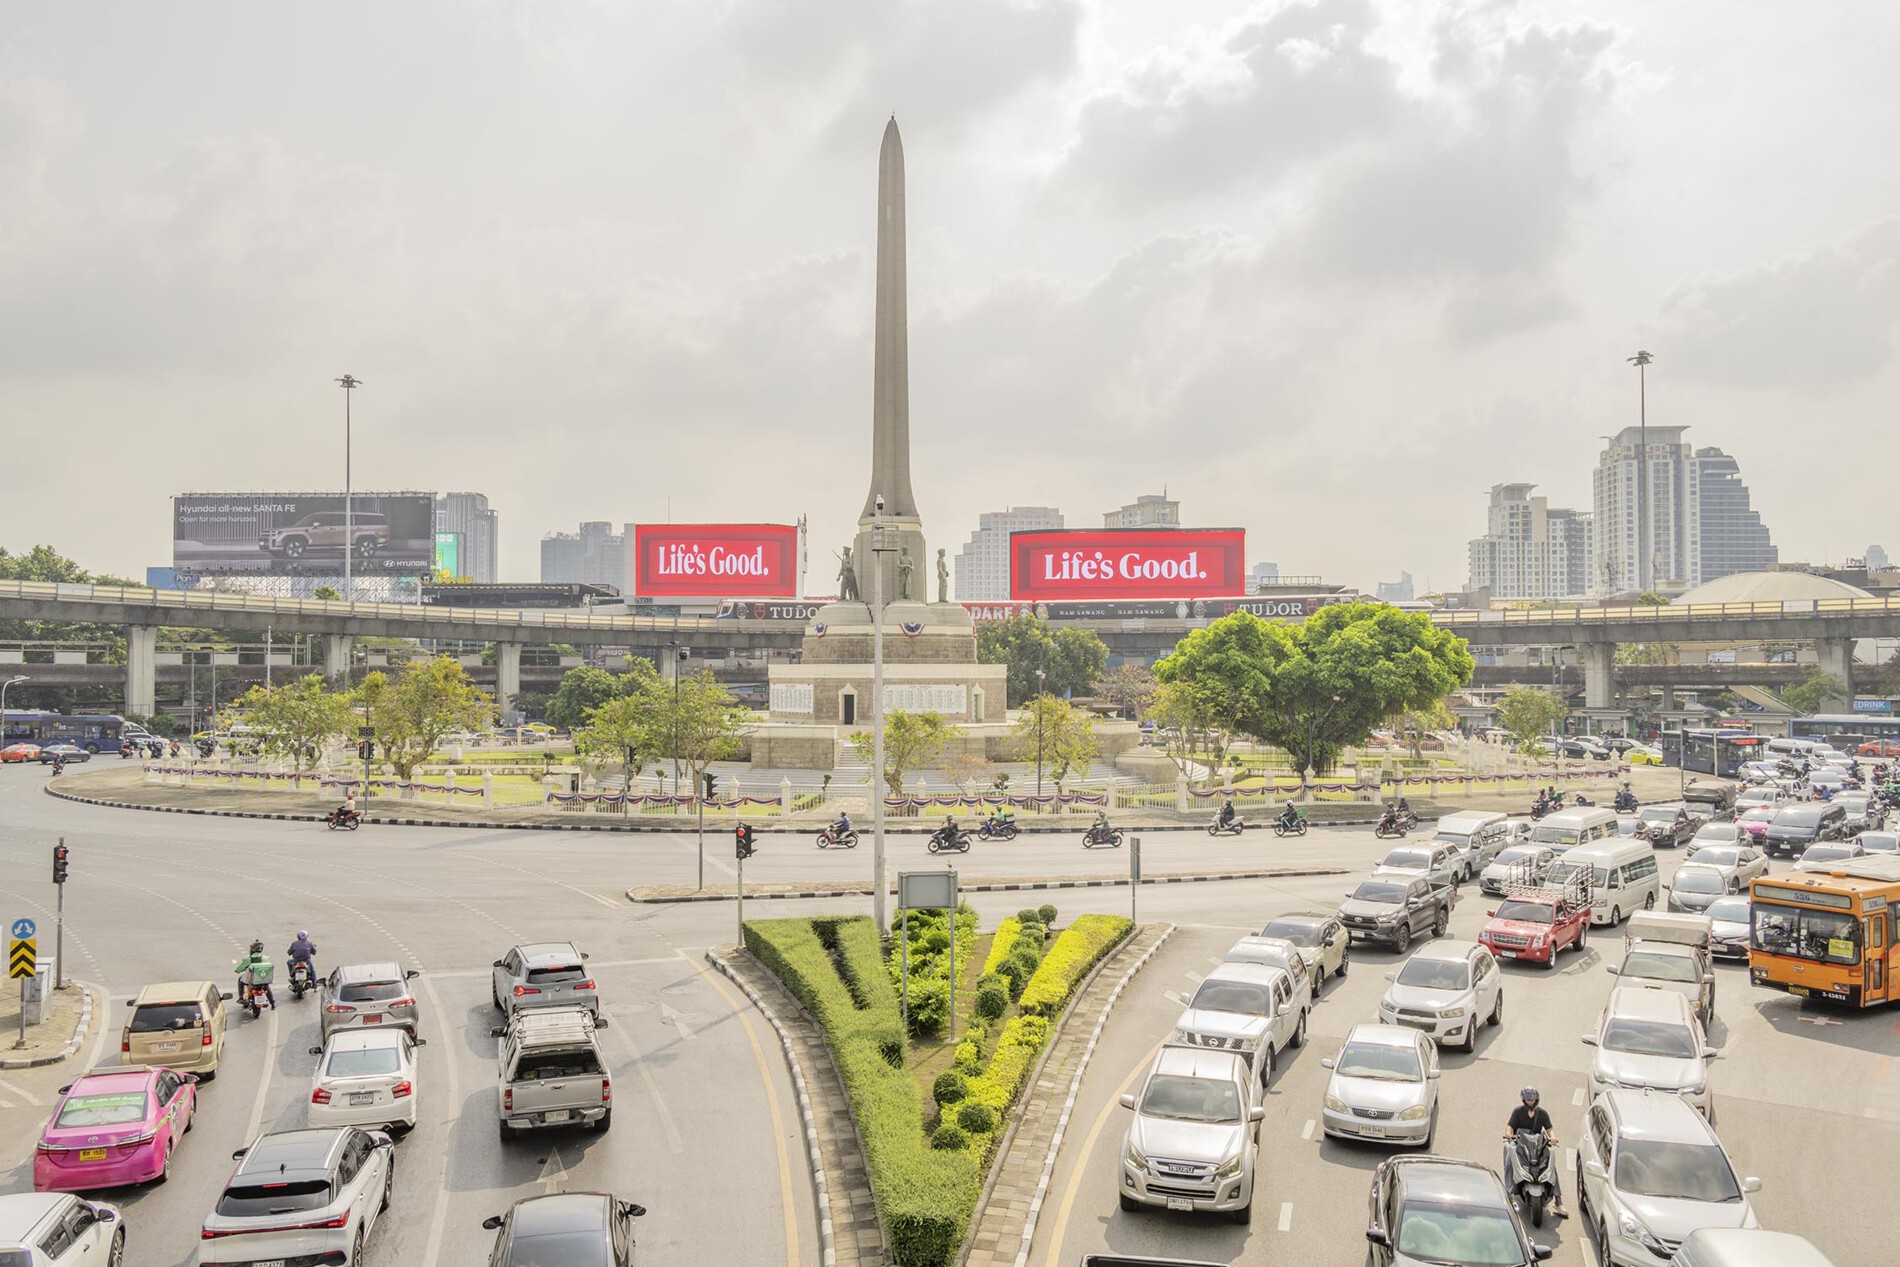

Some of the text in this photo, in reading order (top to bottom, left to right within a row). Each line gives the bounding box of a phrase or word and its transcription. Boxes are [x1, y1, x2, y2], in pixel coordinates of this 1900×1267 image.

[180, 504, 296, 515] Hyundai all-new SANTA FE
[658, 544, 769, 576] Life's Good.
[1044, 551, 1207, 580] Life's Good.
[1239, 602, 1303, 616] TUDOR
[1792, 892, 1811, 902] 536
